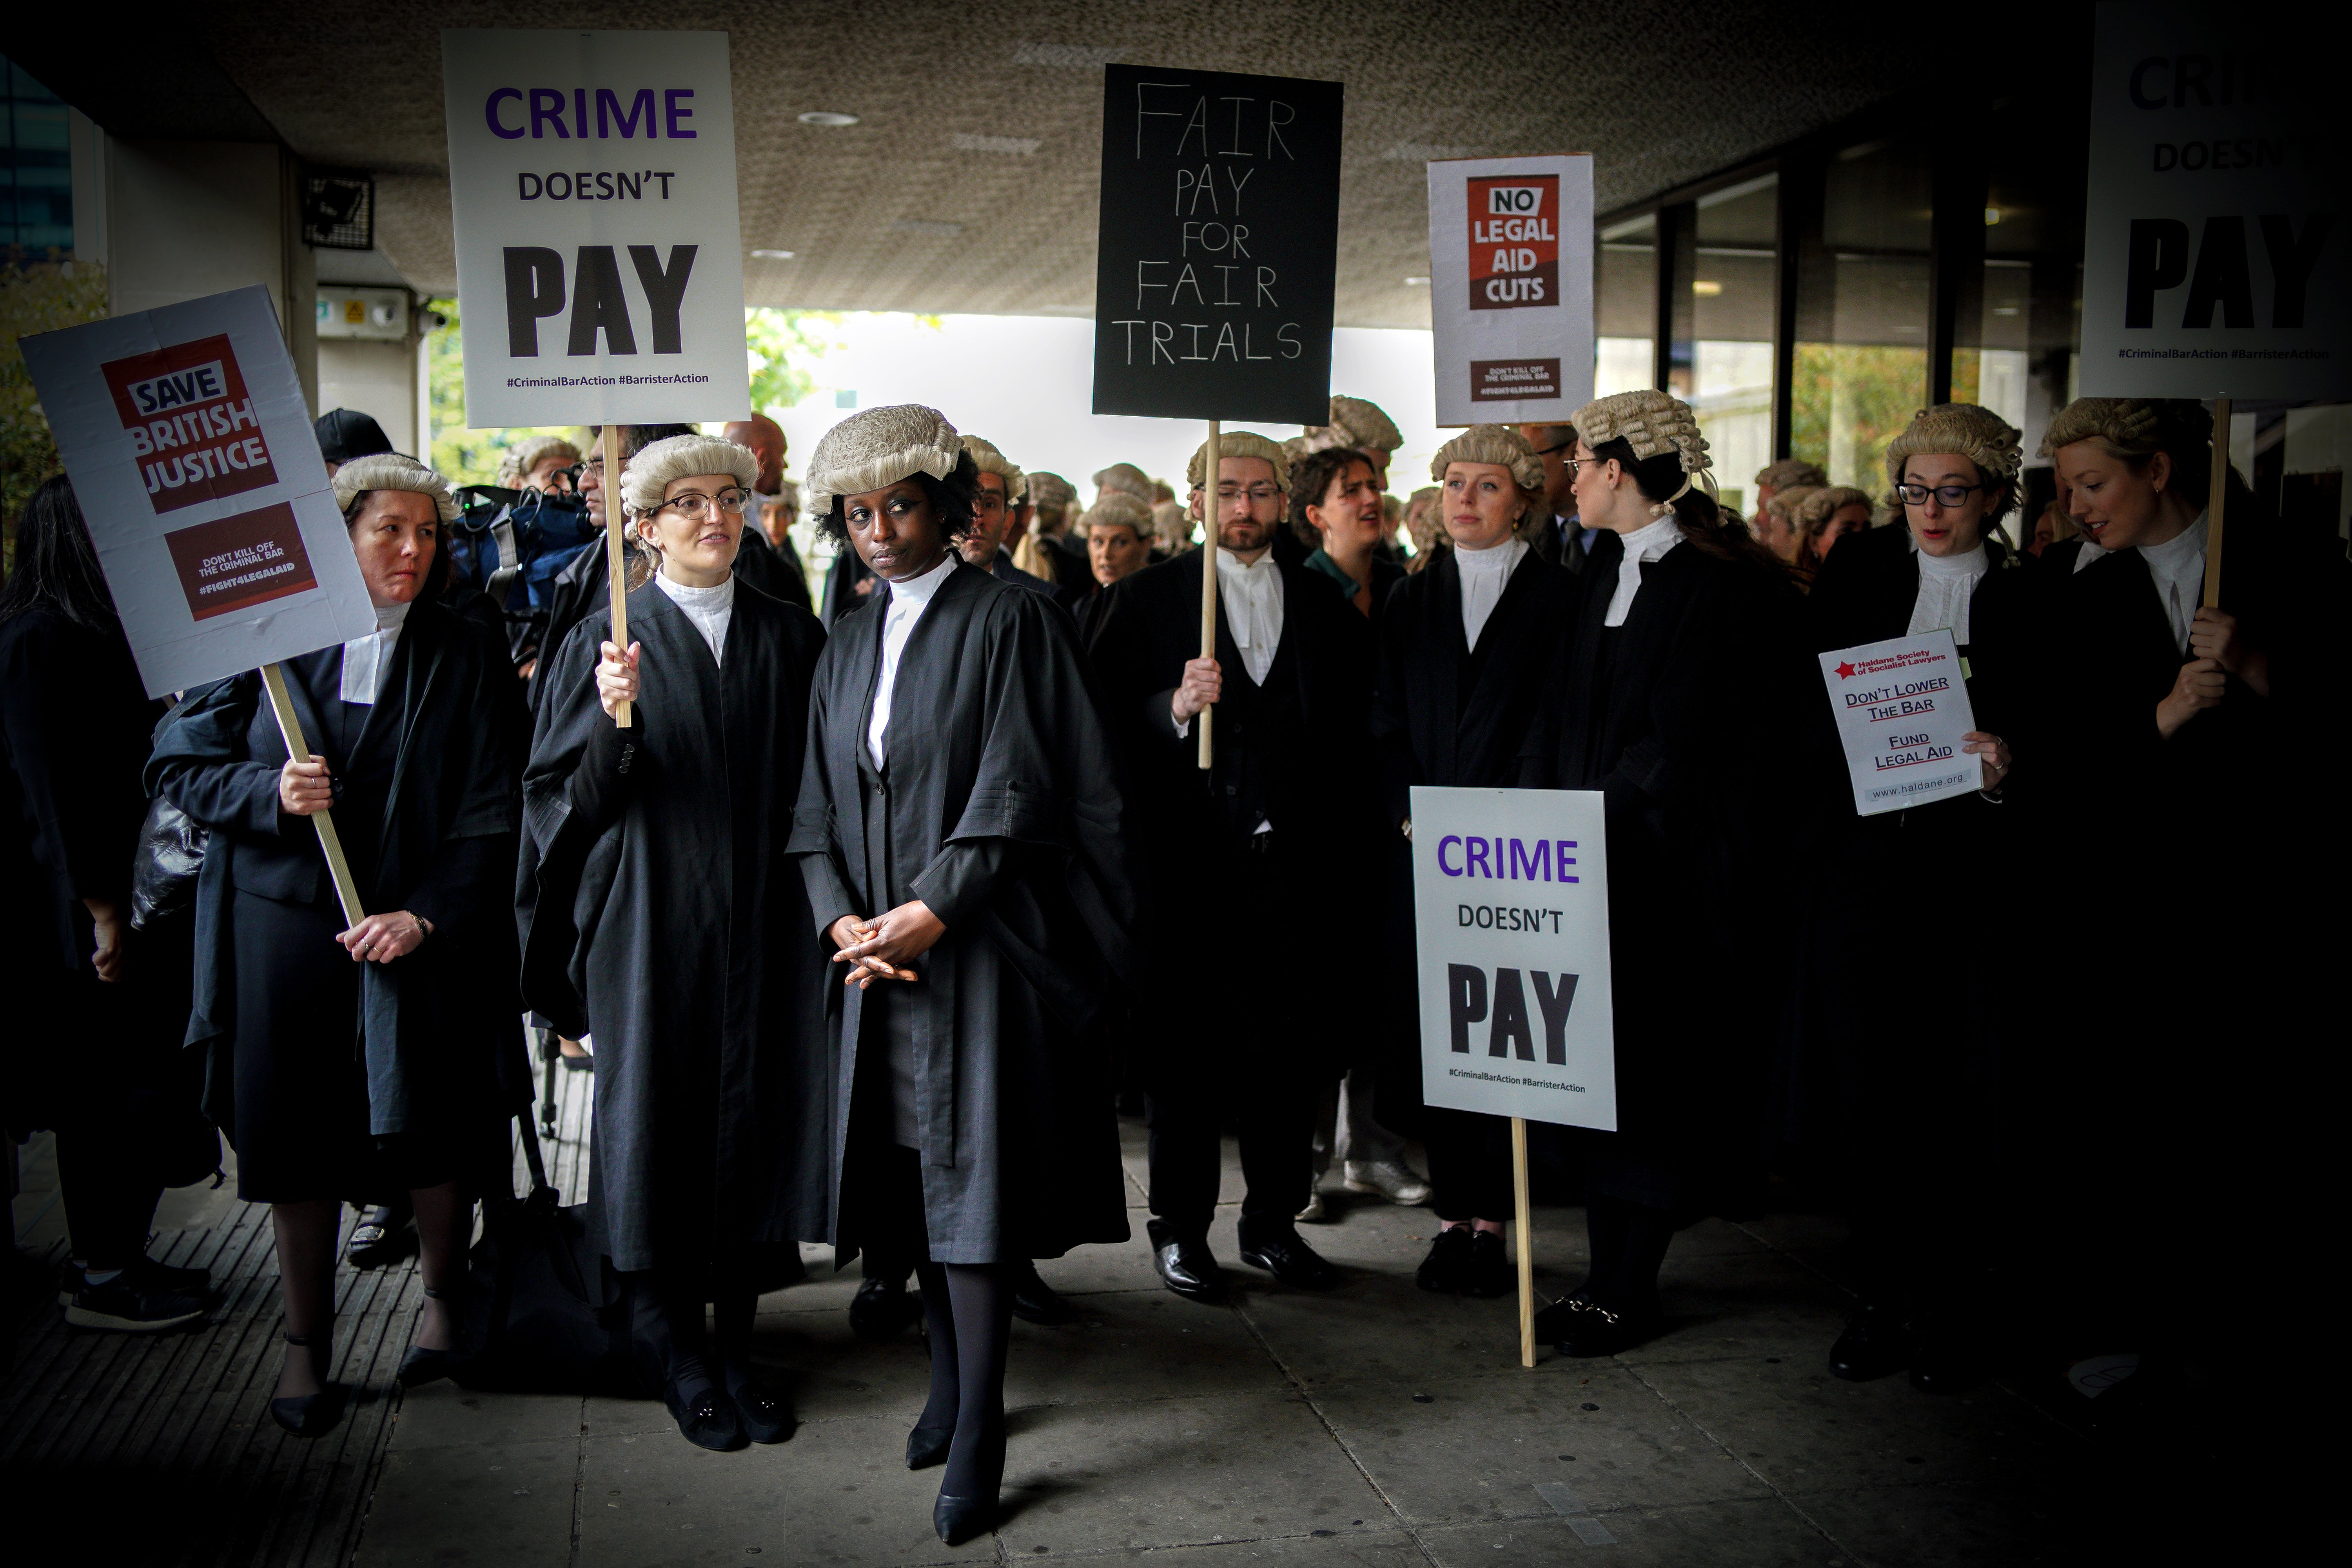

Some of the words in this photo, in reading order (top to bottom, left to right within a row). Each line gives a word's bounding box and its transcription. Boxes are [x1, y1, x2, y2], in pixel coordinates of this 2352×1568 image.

[485, 87, 697, 140] CRIME
[1137, 83, 1295, 160] FAIR
[518, 170, 675, 200] DOESN'T
[1176, 164, 1254, 216] PAY
[1494, 189, 1534, 212] NO
[1183, 222, 1250, 258] FOR
[1474, 218, 1555, 243] LEGAL
[1492, 248, 1537, 273] AID
[2125, 212, 2339, 328] PAY
[1138, 260, 1278, 310] FAIR
[1486, 277, 1544, 302] CUTS
[503, 245, 699, 357] PAY
[1112, 320, 1301, 365] TRIALS
[2119, 348, 2228, 361] #CriminalBarAction
[2231, 348, 2330, 360] #BarristerAction
[136, 368, 221, 413] SAVE
[507, 375, 616, 388] #CriminalBarAction
[619, 373, 709, 385] #BarristerAction
[125, 397, 258, 457] BRITISH
[145, 437, 268, 493] JUSTICE
[199, 566, 218, 577] THE
[220, 554, 263, 571] CRIMINAL
[265, 548, 284, 559] BAR
[203, 552, 231, 567] DON'T
[234, 547, 255, 559] KILL
[256, 541, 274, 552] OFF
[199, 563, 295, 595] #FIGHT4LEGALAID
[1858, 657, 1895, 668] Haldane
[1896, 650, 1929, 661] Society
[1868, 661, 1906, 673] Socialist
[1908, 654, 1946, 665] Lawyers
[1873, 774, 1963, 798] www.haldane.org
[1437, 835, 1579, 883] CRIME
[1458, 904, 1564, 934] DOESN'T
[1448, 963, 1580, 1066] PAY
[1449, 1068, 1521, 1085] #CriminalBarAction
[1523, 1077, 1586, 1093] #BarristerAction
